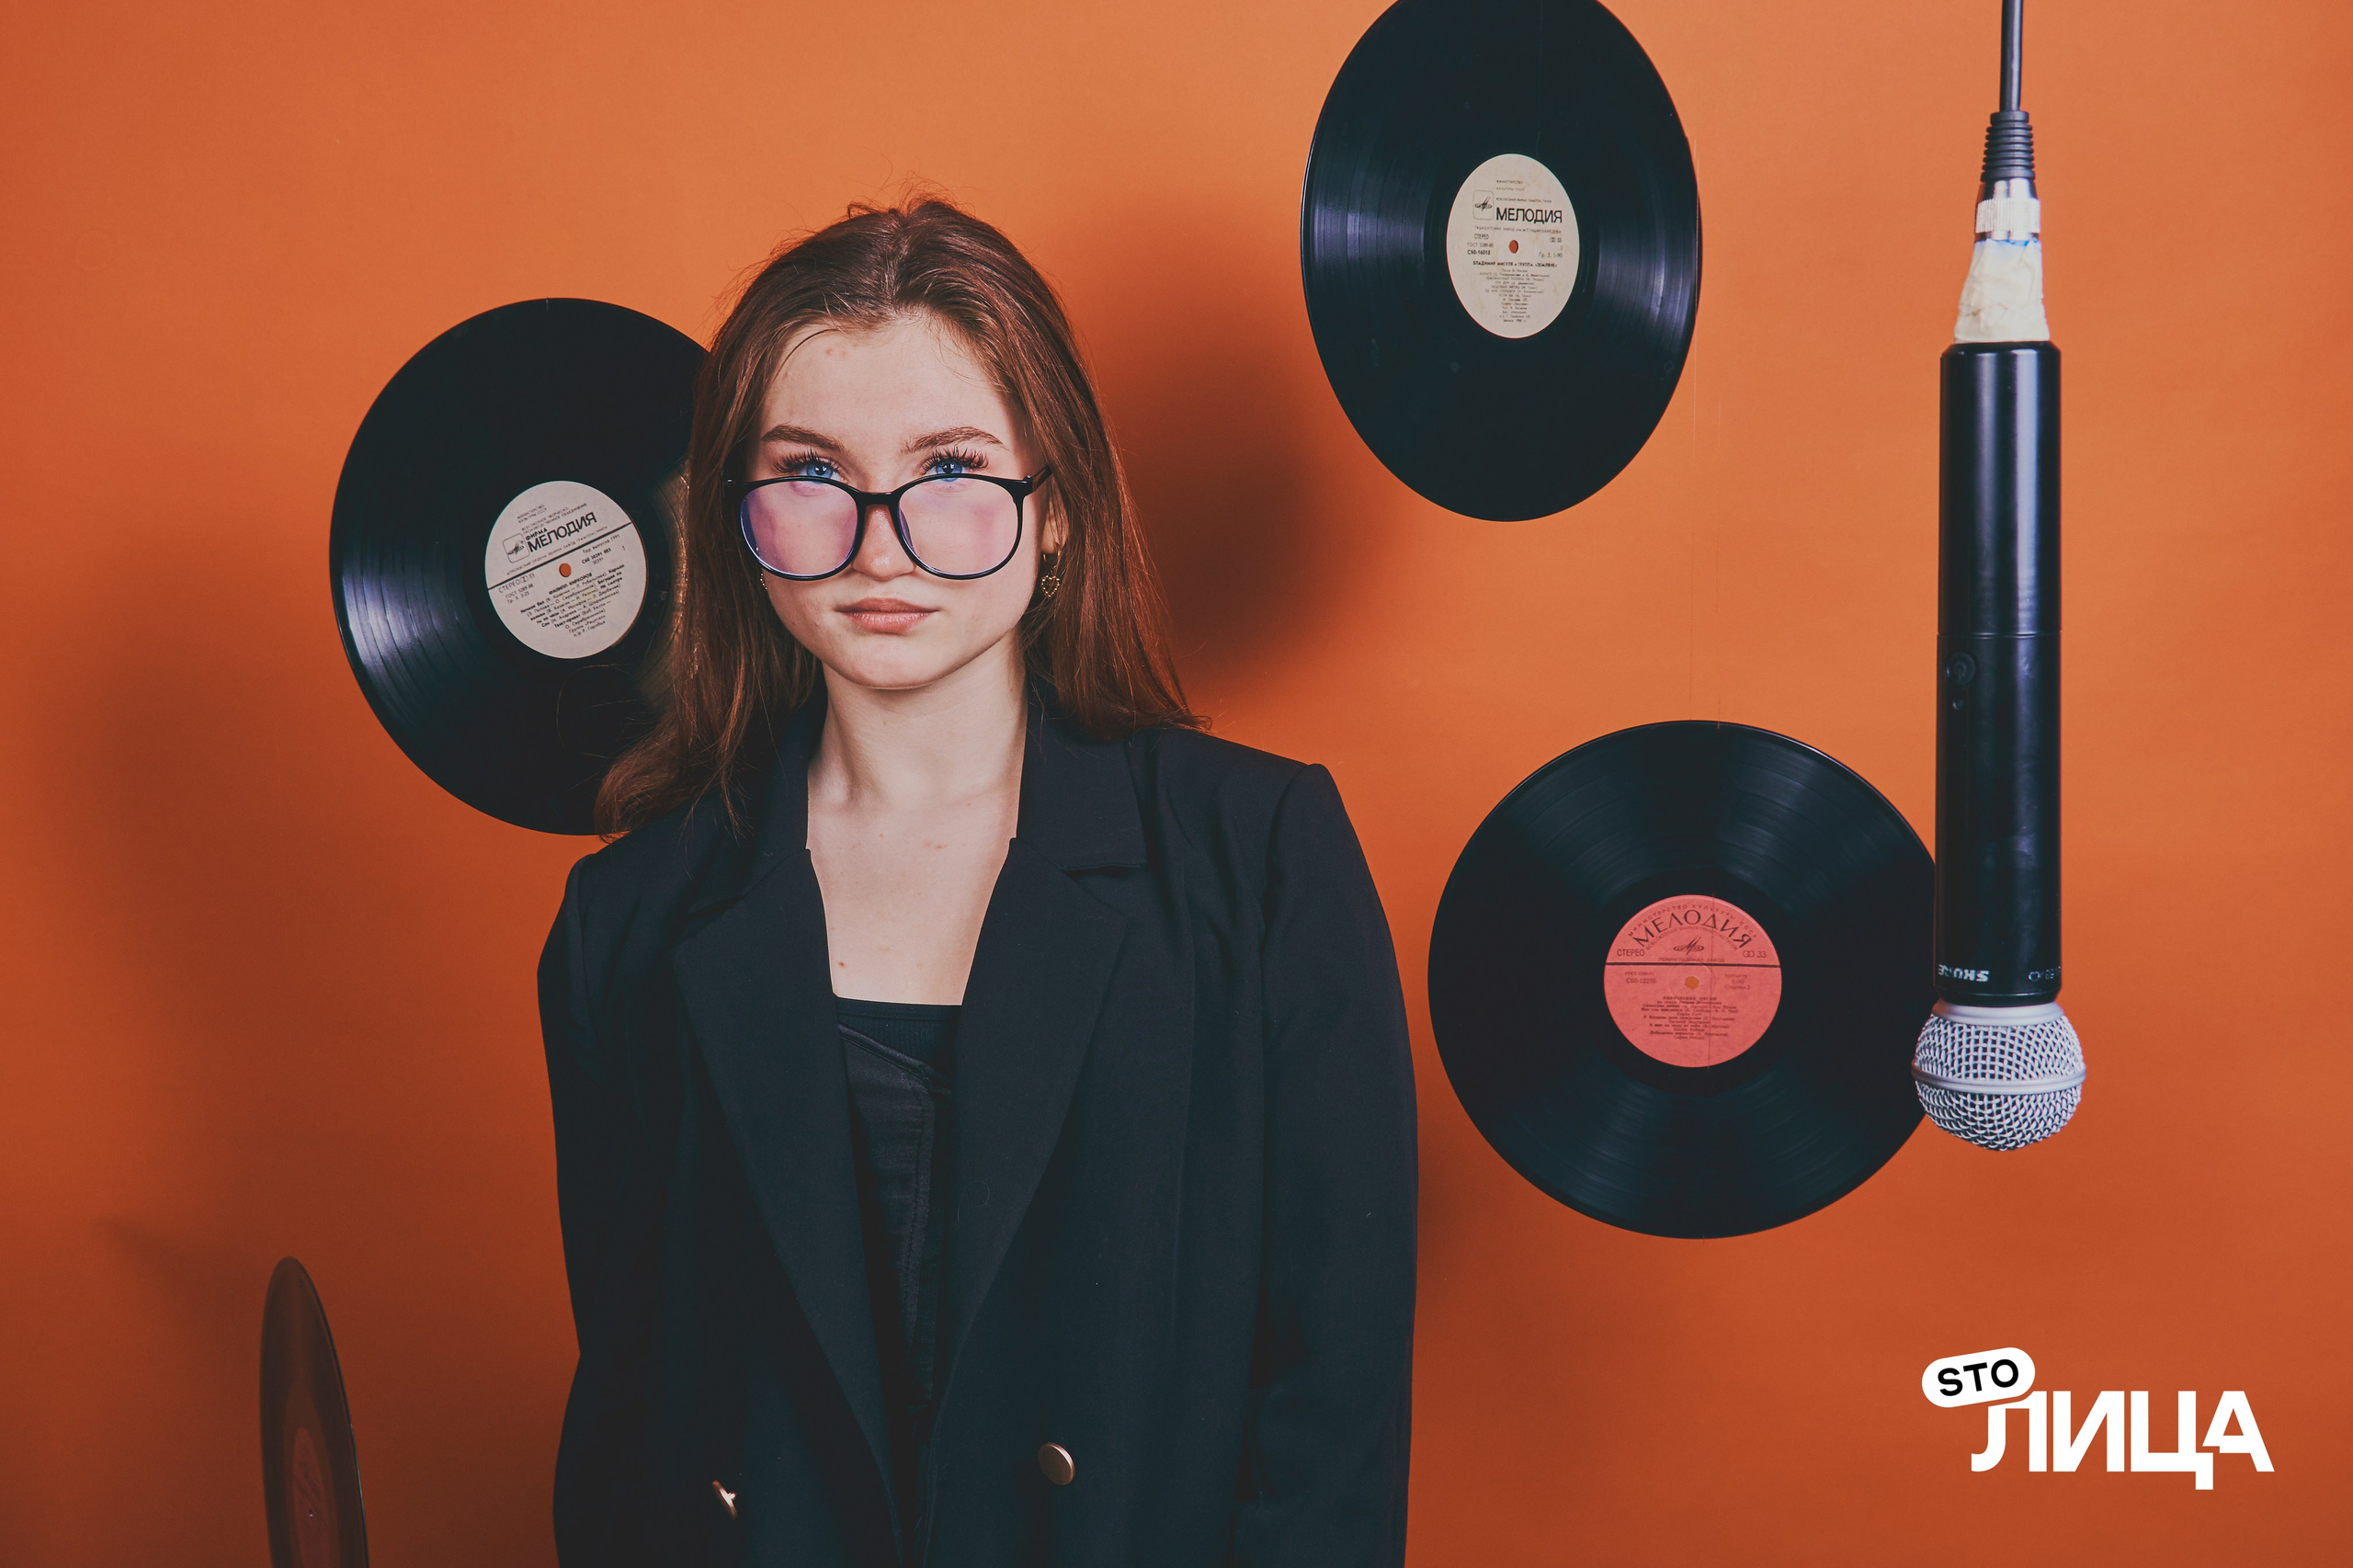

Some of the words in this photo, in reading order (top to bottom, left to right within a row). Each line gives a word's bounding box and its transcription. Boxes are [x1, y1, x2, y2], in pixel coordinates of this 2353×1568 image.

[1495, 207, 1563, 224] МЕЛОДИЯ
[525, 528, 548, 540] ФИРМА
[527, 511, 597, 552] МЕЛОДИЯ
[498, 579, 520, 593] СТЕРЕО
[549, 584, 568, 596] ФИЛИПП
[569, 573, 592, 585] КИРКОРОВ
[1629, 904, 1688, 937] МИНИСТЕРСТВО
[1692, 903, 1736, 920] КУЛЬТУРЫ
[1632, 909, 1752, 949] МЕЛОДИЯ
[1617, 948, 1645, 958] СТЕРЕО
[1756, 950, 1768, 959] 33
